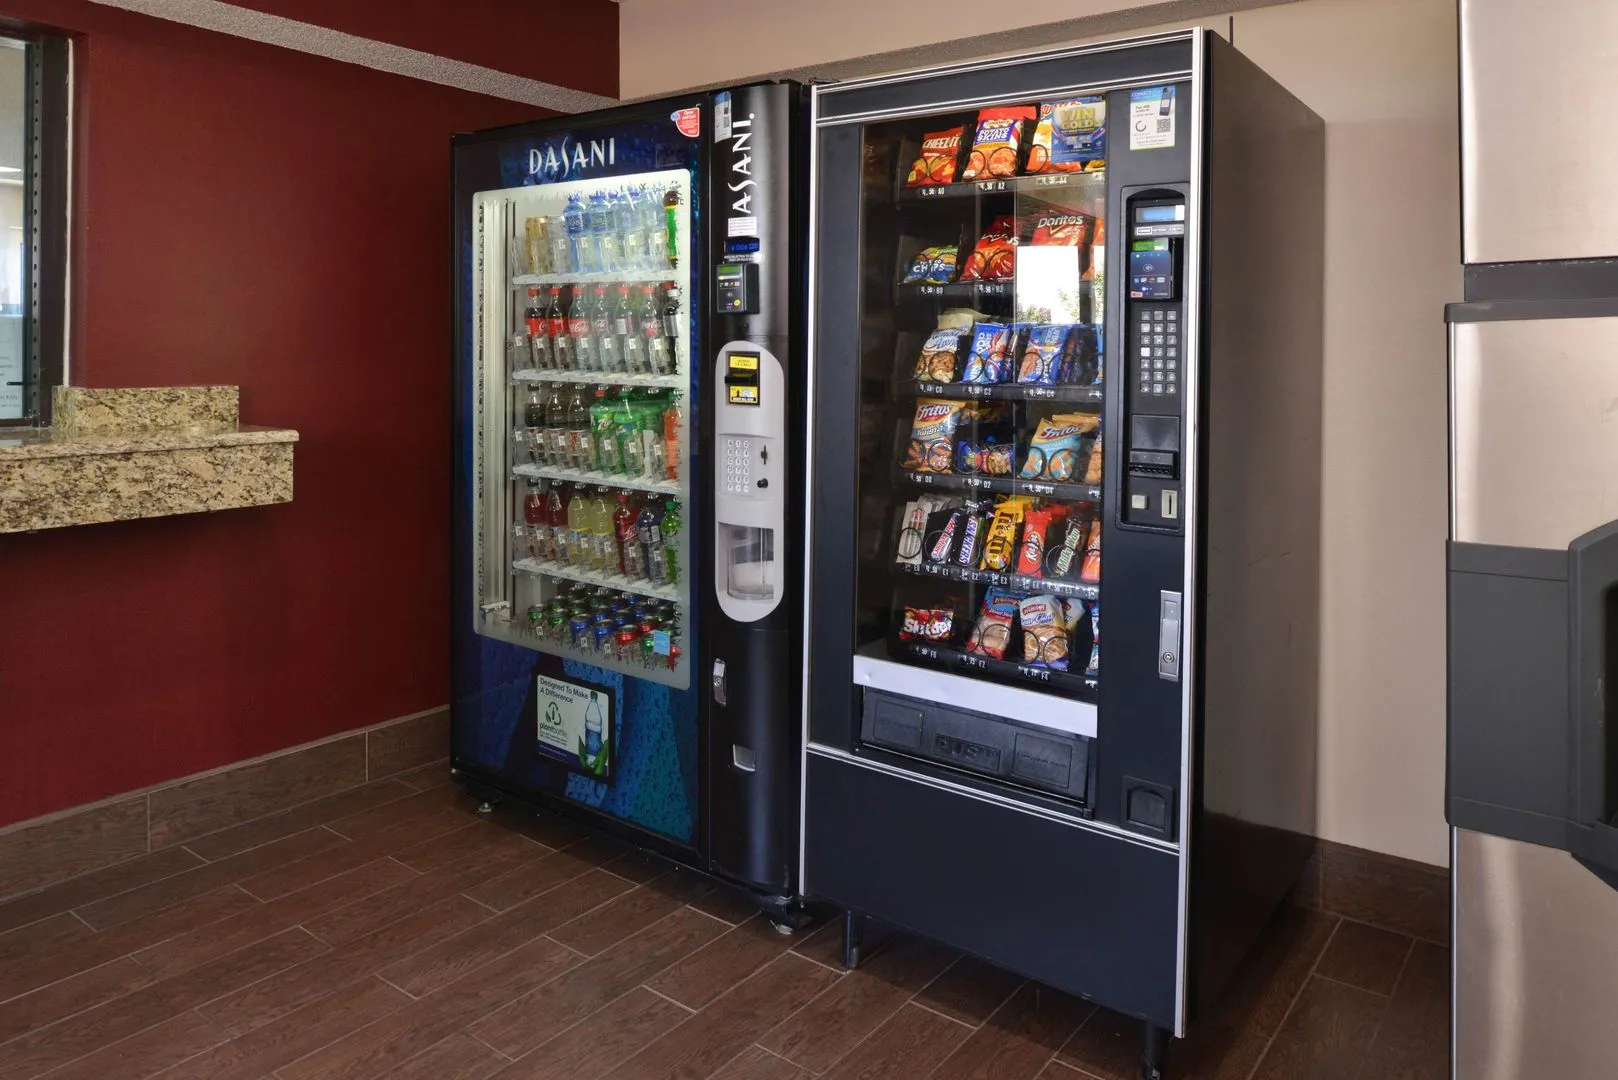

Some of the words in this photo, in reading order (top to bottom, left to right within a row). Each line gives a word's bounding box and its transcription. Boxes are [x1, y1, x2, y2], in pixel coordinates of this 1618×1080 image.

[529, 136, 615, 178] DASANI
[1037, 215, 1084, 229] Doritos
[918, 405, 951, 420] Fritos
[959, 518, 978, 565] SNICKERS
[1065, 527, 1081, 551] Way
[1057, 546, 1075, 574] Milky
[540, 677, 565, 692] Designed
[566, 685, 573, 694] To
[573, 688, 589, 700] Make
[545, 688, 574, 704] Difference
